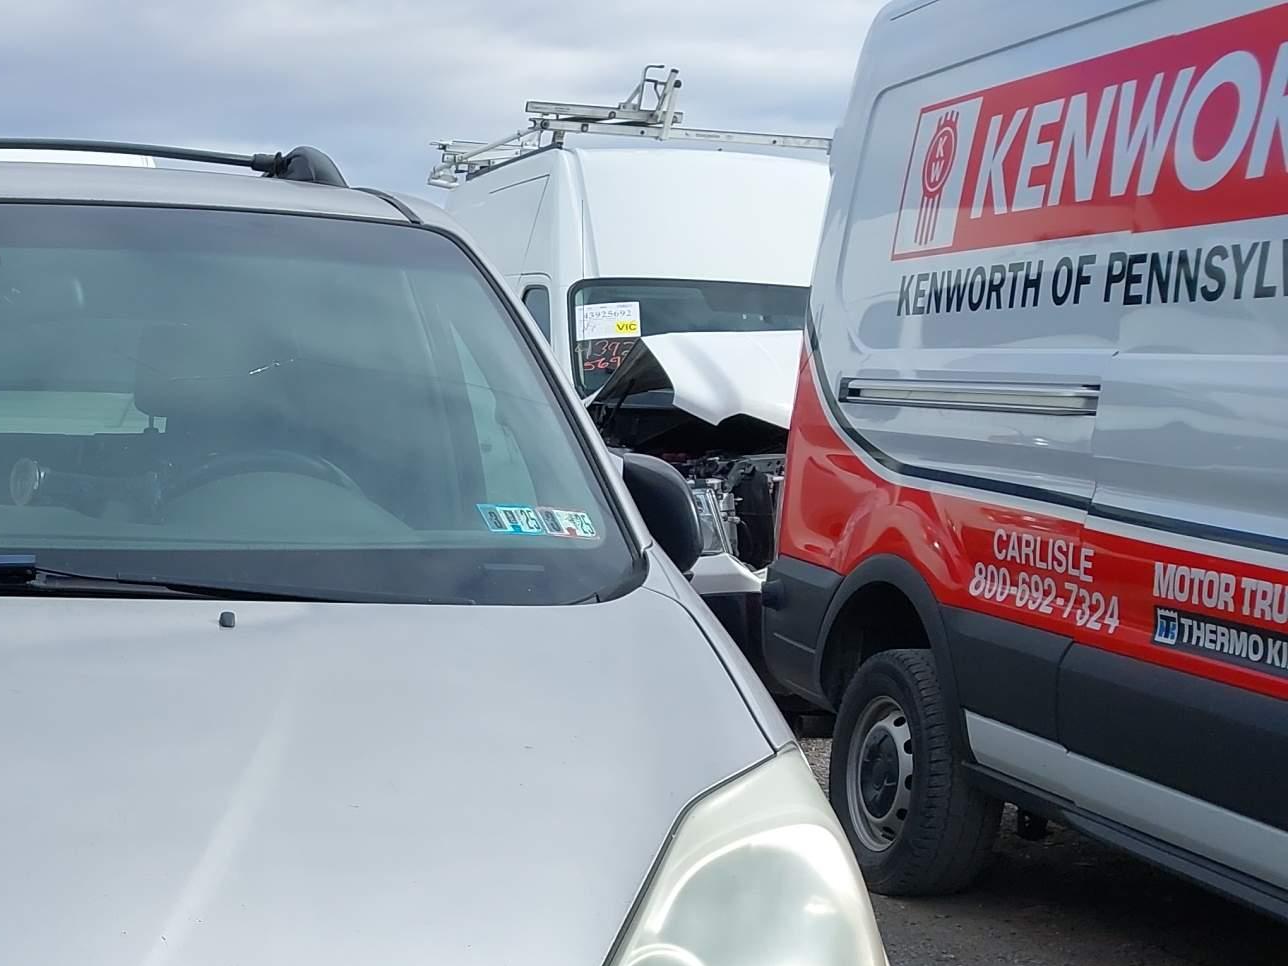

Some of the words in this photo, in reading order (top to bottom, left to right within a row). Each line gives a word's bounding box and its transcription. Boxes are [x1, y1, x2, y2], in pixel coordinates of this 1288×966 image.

[897, 259, 1044, 317] KENWORTH
[1051, 253, 1098, 307] OF
[1103, 237, 1288, 306] PENNSYL
[615, 323, 638, 331] VIC
[993, 528, 1096, 583] CARLISLE
[968, 562, 1121, 634] 800-692-7324
[1152, 561, 1237, 613] MOTOR
[1179, 616, 1264, 662] THERMO
